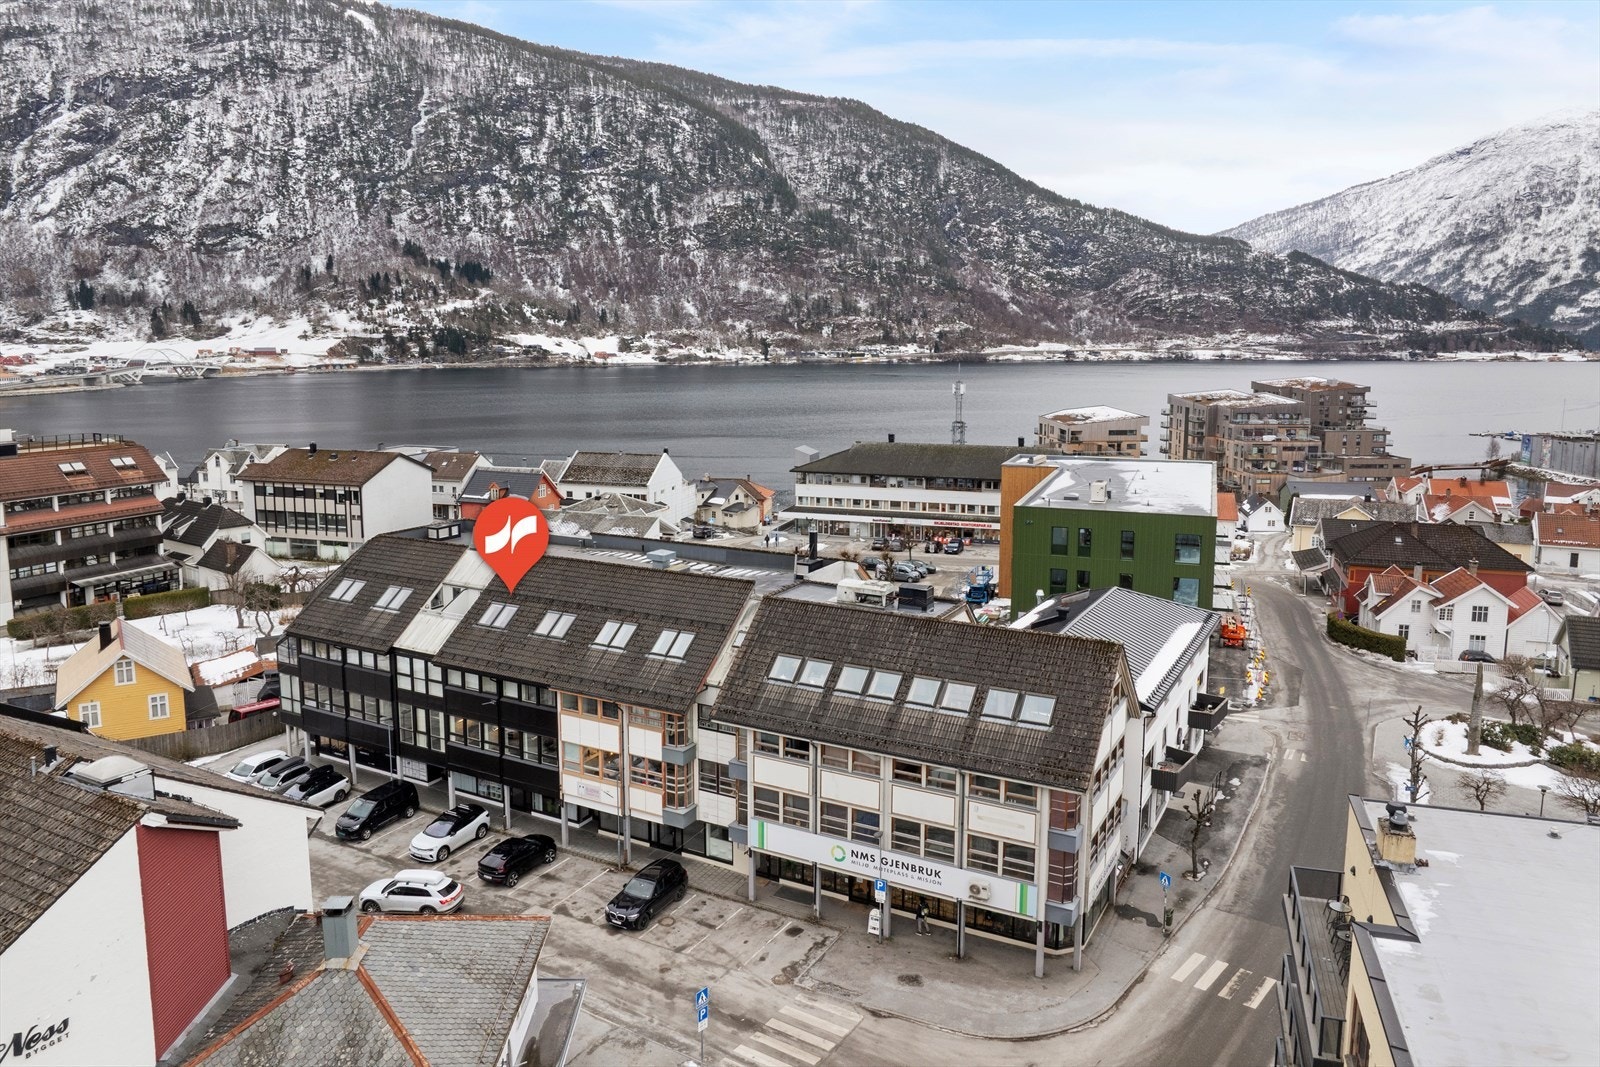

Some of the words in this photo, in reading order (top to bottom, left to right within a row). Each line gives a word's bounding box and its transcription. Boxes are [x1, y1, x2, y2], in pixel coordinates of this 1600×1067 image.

[850, 849, 876, 863] NMS
[880, 857, 942, 879] GJENBRUK
[850, 859, 869, 869] MILJØ
[873, 865, 909, 878] MØTEPLASS
[916, 876, 943, 886] MISJON
[877, 881, 884, 890] P
[700, 1008, 706, 1019] P
[0, 1017, 70, 1064] Ness
[25, 1032, 70, 1060] BYGGET
